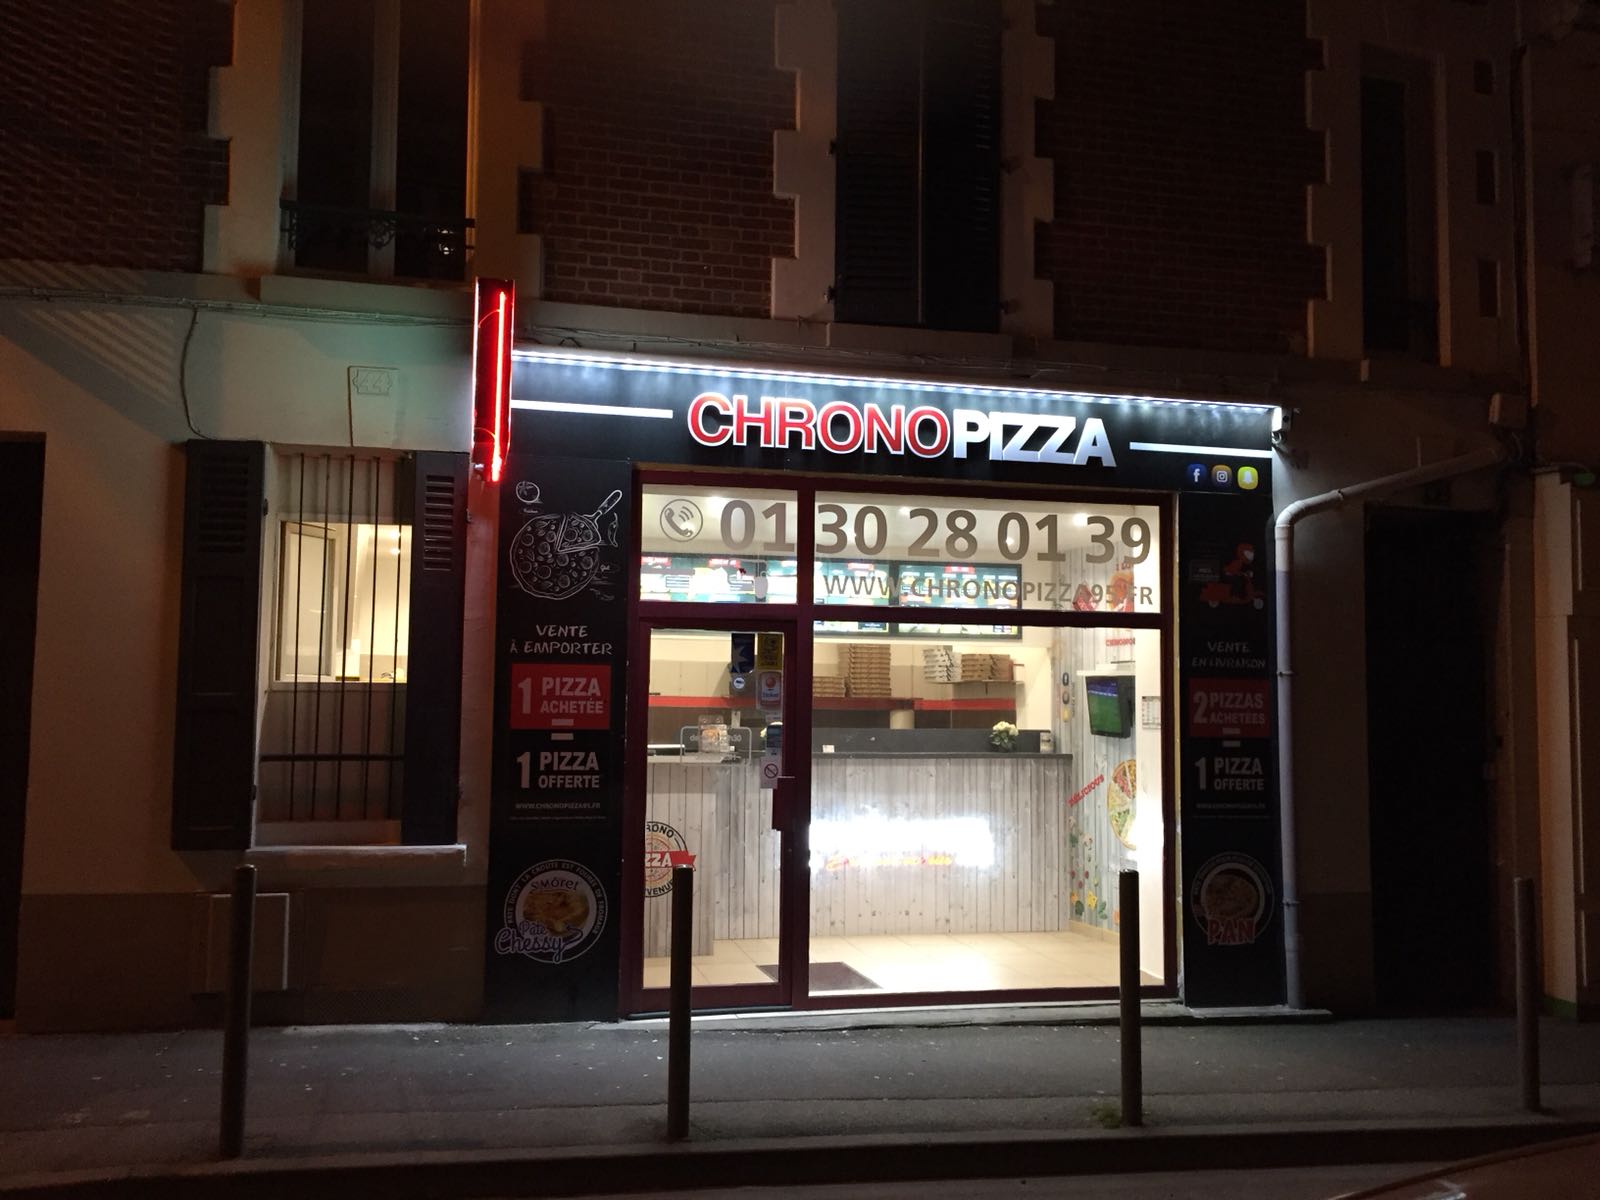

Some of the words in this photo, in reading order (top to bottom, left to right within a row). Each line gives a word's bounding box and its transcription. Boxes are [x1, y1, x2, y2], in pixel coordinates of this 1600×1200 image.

[687, 391, 1117, 468] CHRONOPIZZA
[720, 499, 795, 552] 01
[815, 503, 888, 555] 30
[907, 508, 978, 559] 28
[997, 511, 1066, 562] 01
[1085, 516, 1151, 565] 39
[536, 624, 589, 638] VENTE
[524, 641, 613, 655] EMPORTER
[1207, 641, 1250, 653] VENTE
[518, 677, 532, 714] 1
[541, 676, 601, 696] PIZZA
[540, 697, 604, 714] ACHETÉE
[1193, 690, 1208, 724] 2
[1209, 691, 1264, 709] PIZZAS
[516, 751, 531, 788] 1
[539, 751, 600, 771] PIZZA
[538, 775, 600, 789] OFFERTE
[1194, 757, 1207, 790] 1
[1213, 757, 1264, 775] PIZZA
[1213, 778, 1265, 790] OFFERTE
